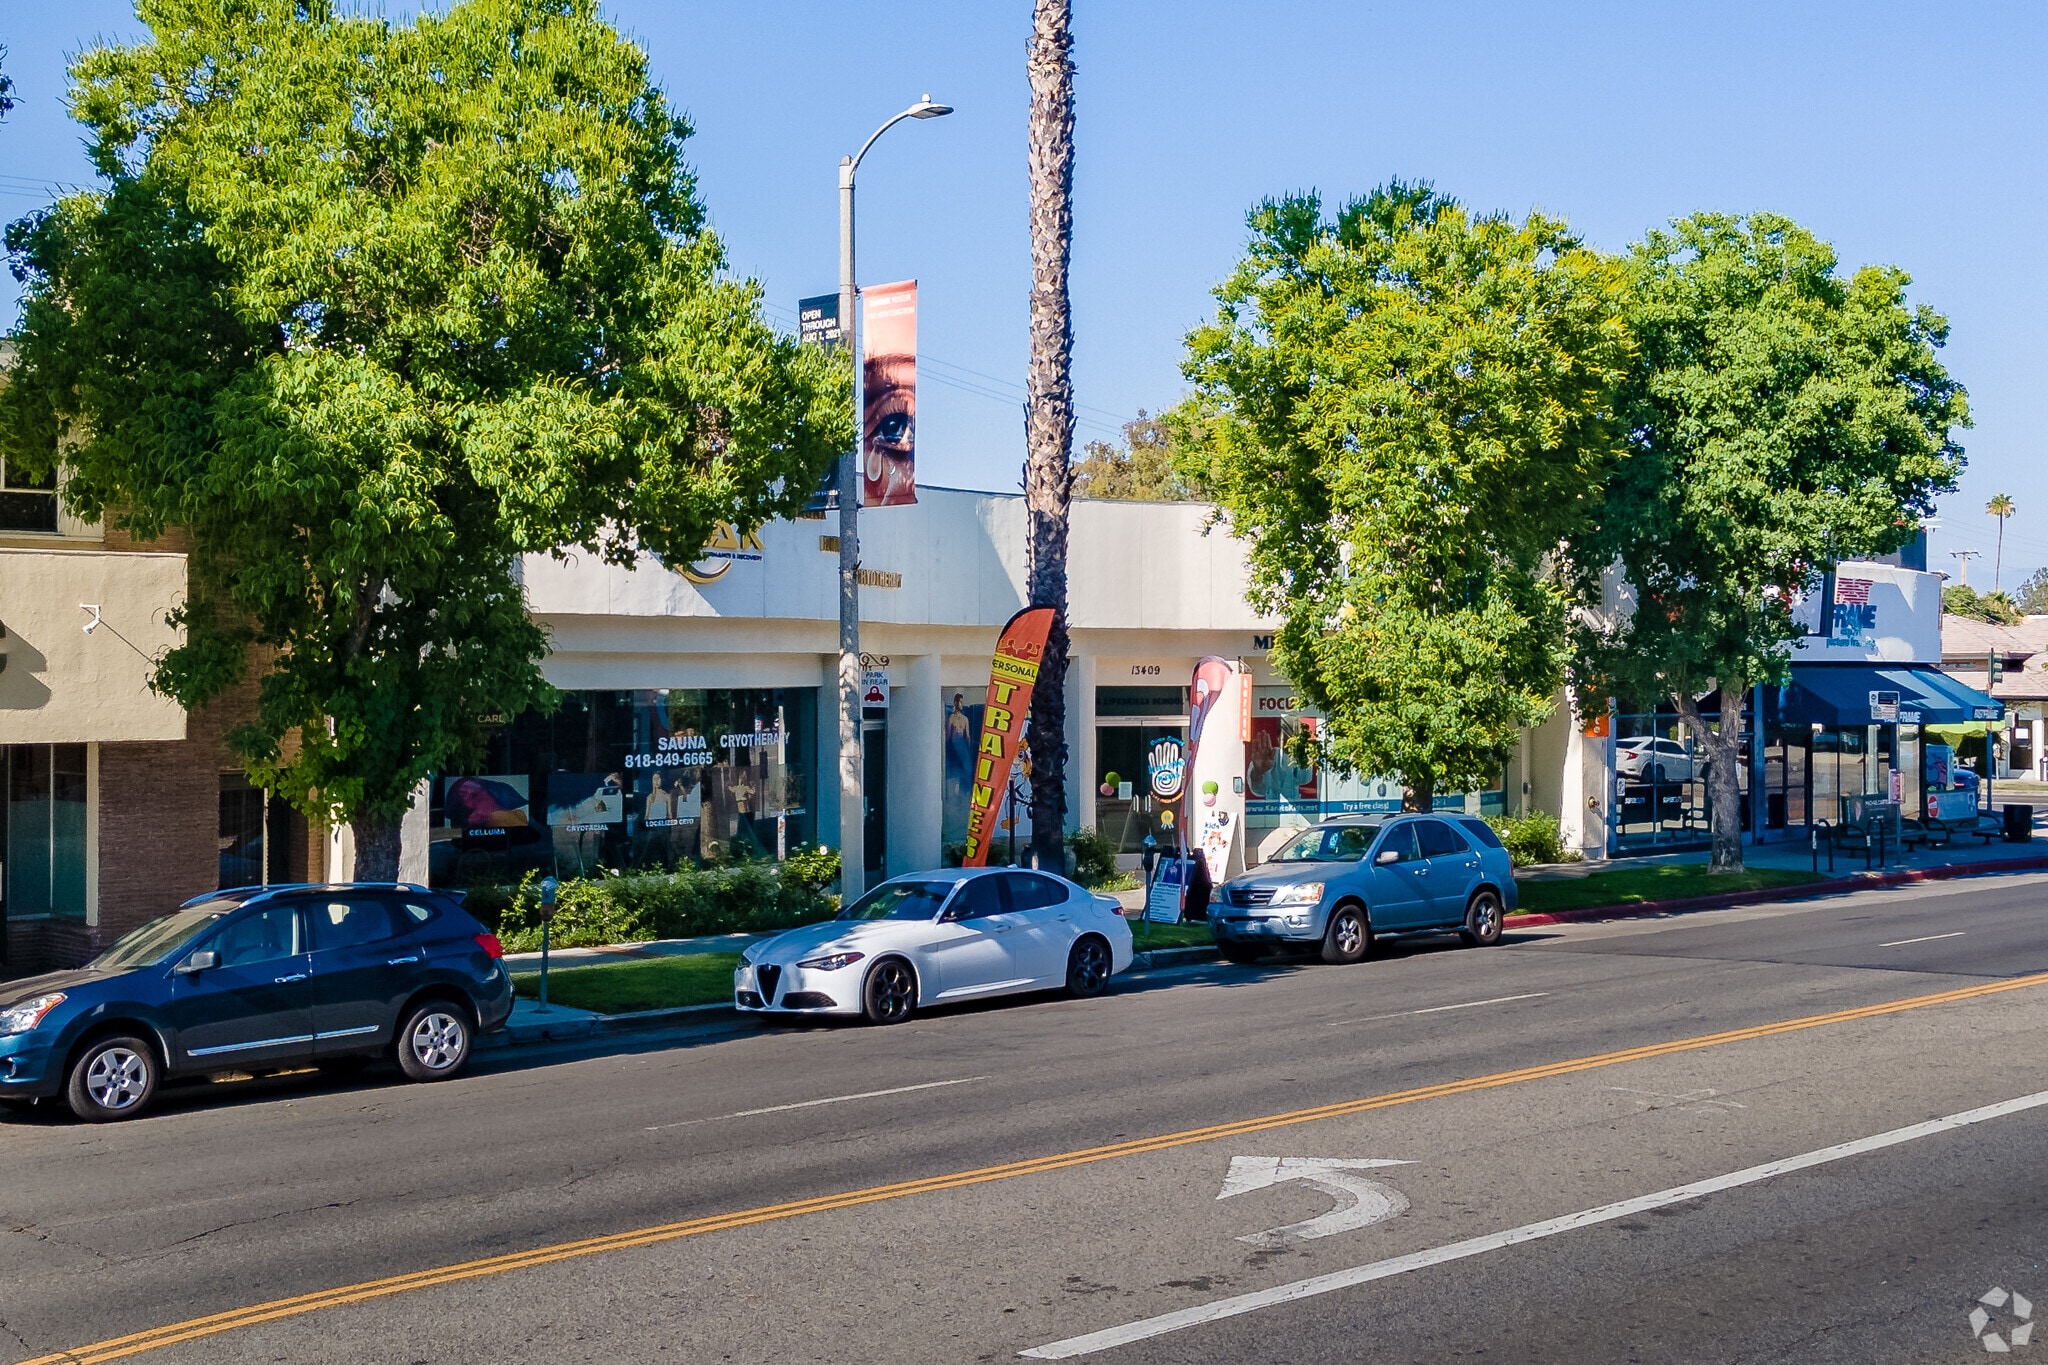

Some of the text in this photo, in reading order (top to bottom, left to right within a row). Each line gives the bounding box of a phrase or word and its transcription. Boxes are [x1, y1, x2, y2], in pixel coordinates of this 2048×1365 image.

[801, 309, 821, 321] OPEN
[801, 317, 836, 331] THROUGH
[992, 658, 1037, 679] ERSONAL
[1131, 665, 1161, 675] 13409
[658, 731, 790, 751] SAUNA CRYOTHERAY
[624, 752, 714, 768] 818-849-6665
